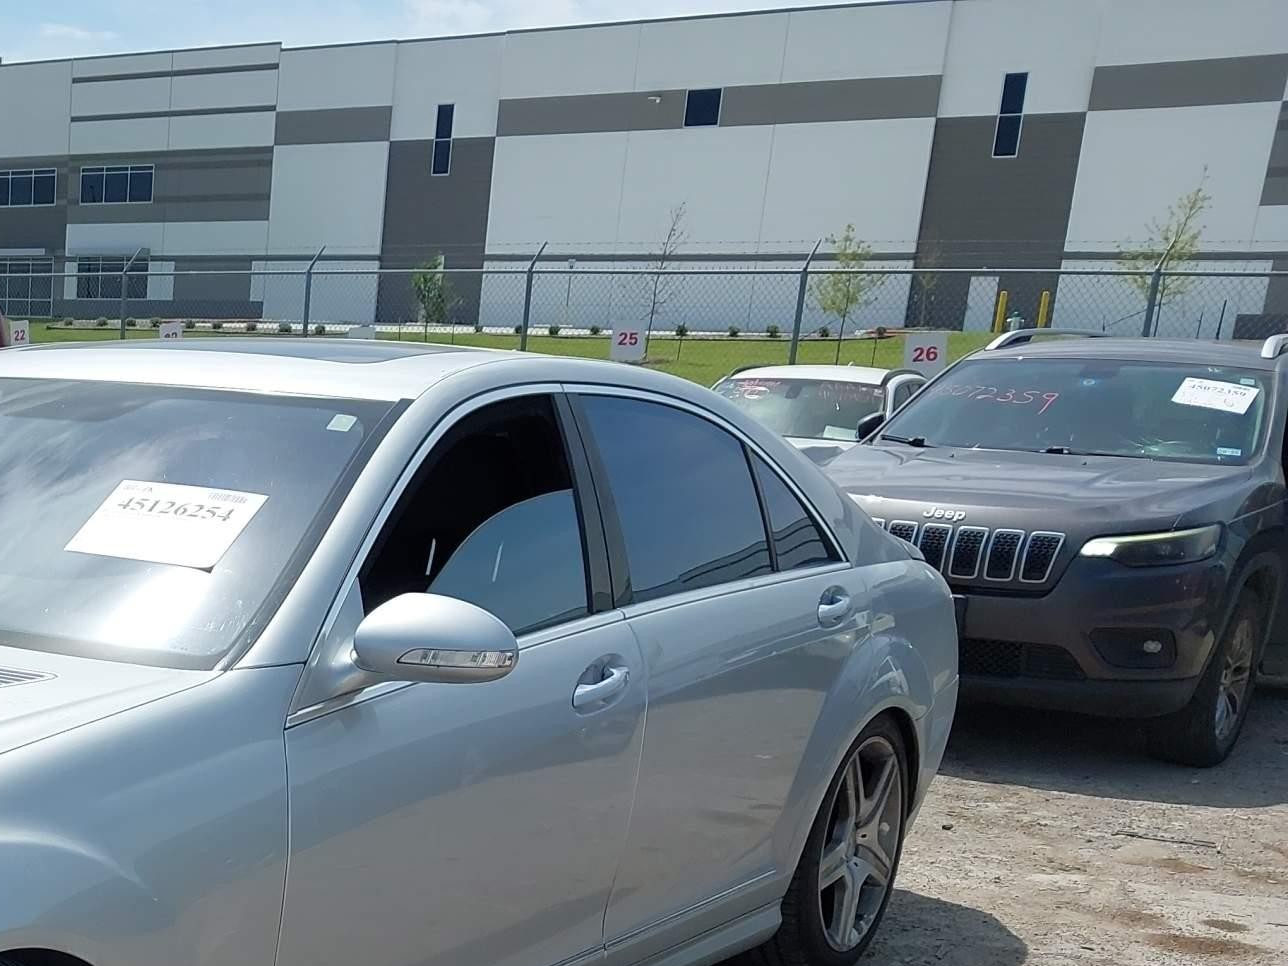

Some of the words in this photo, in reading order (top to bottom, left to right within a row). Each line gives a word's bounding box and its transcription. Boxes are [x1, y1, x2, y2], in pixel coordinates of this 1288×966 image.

[14, 329, 26, 341] 22
[617, 332, 638, 346] 25
[912, 346, 938, 362] 26
[117, 496, 235, 522] 45126254
[922, 506, 966, 522] Jeep
